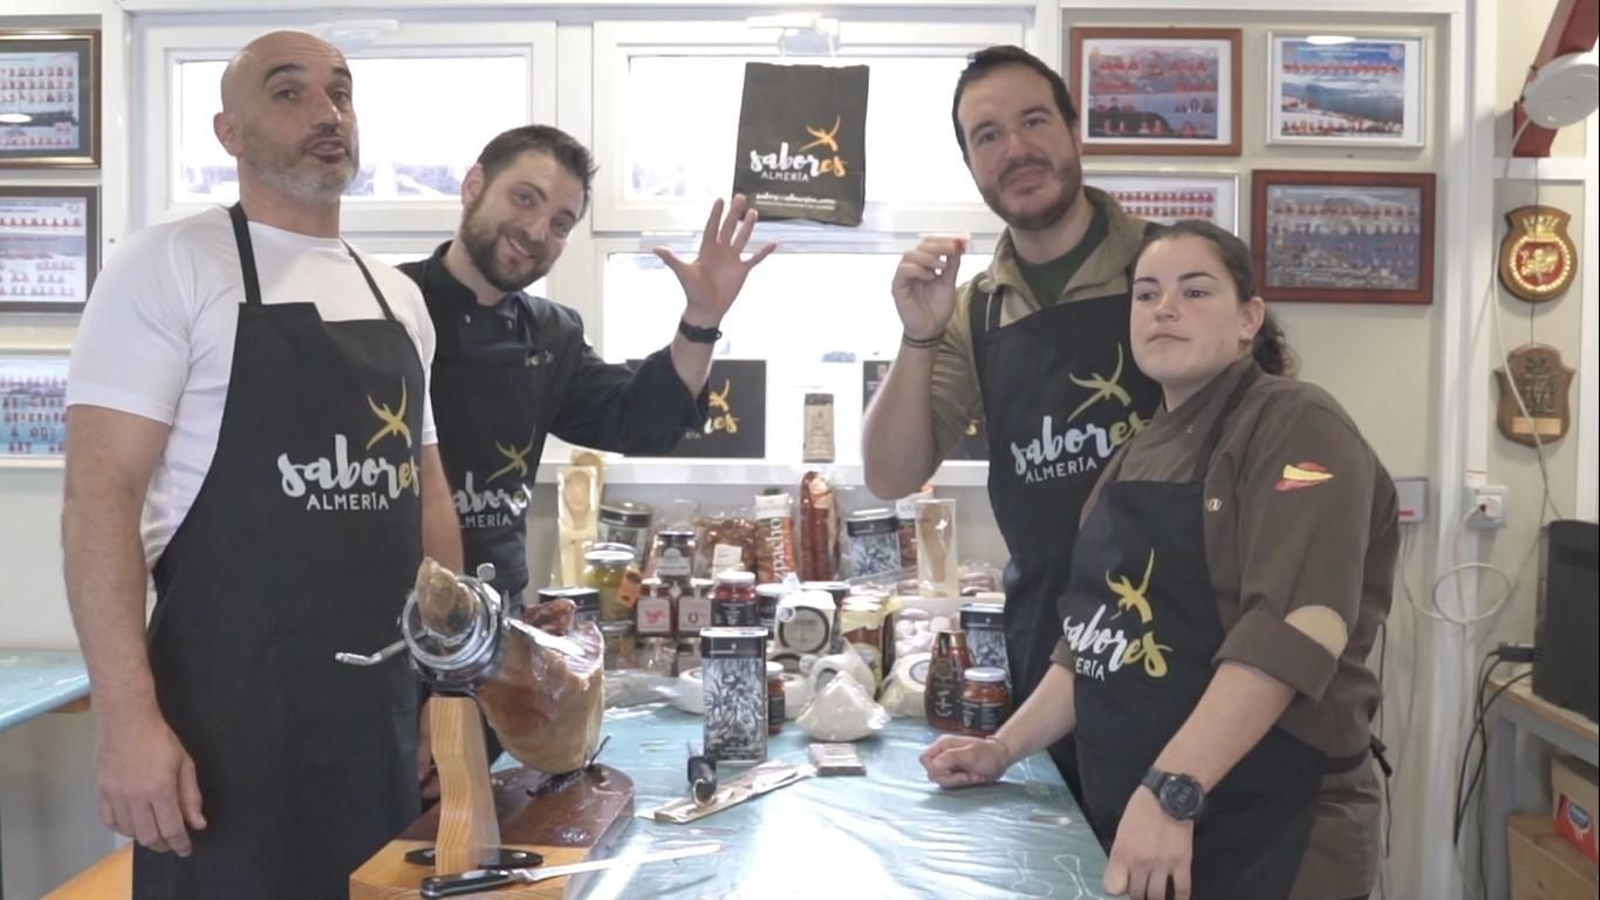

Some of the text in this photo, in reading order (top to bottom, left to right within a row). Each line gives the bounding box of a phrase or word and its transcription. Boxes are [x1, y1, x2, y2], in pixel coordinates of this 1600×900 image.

[750, 142, 848, 178] sabores
[277, 434, 420, 498] sabores
[453, 471, 532, 516] abores
[1075, 657, 1105, 681] ERÍA
